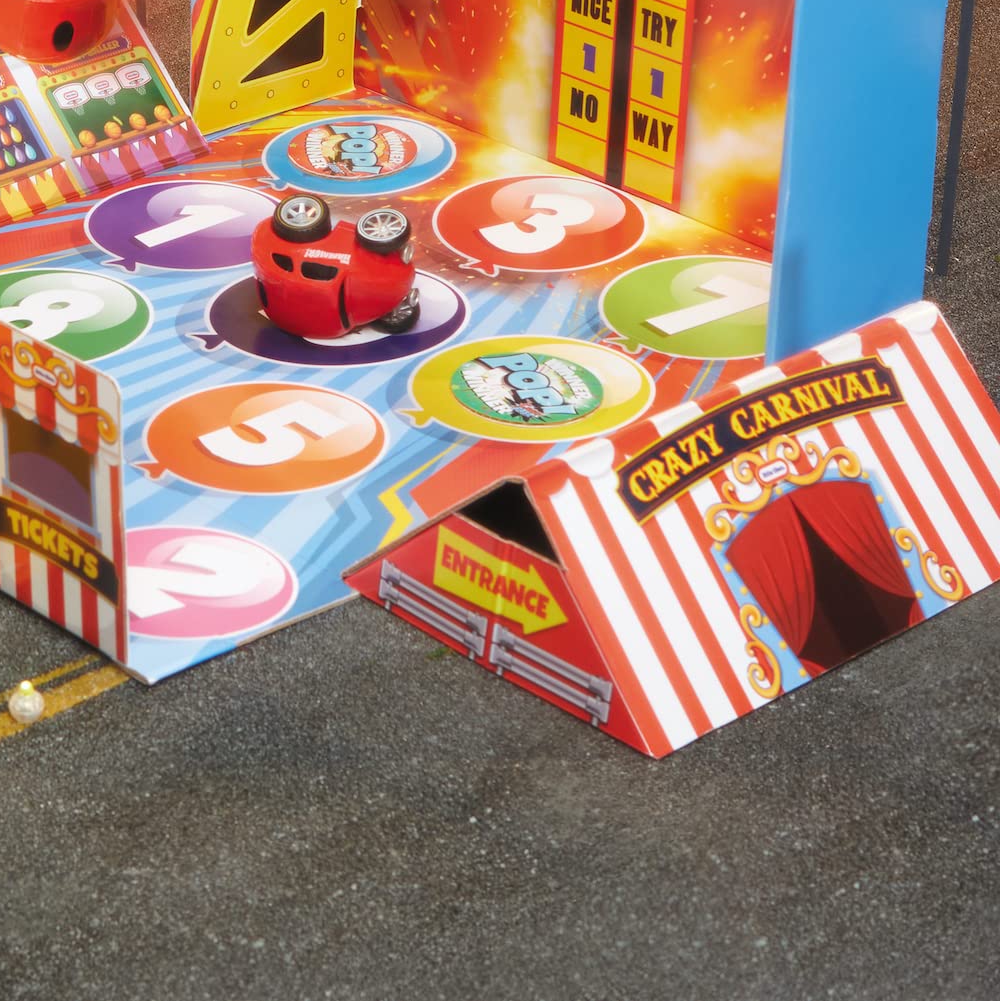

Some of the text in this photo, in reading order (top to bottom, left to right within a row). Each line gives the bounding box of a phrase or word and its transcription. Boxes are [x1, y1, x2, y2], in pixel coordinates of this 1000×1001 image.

[641, 7, 677, 49] TRY
[582, 42, 597, 72] 1
[650, 67, 665, 98] 1
[571, 87, 598, 123] NO
[632, 111, 674, 153] WAY
[134, 204, 246, 248] 1
[479, 193, 595, 254] 3
[477, 353, 578, 415] POP!
[197, 400, 349, 466] 5
[628, 368, 891, 503] CRAZY CARNIVAL
[7, 506, 99, 580] TICKETS
[441, 544, 550, 620] ENTRANCE
